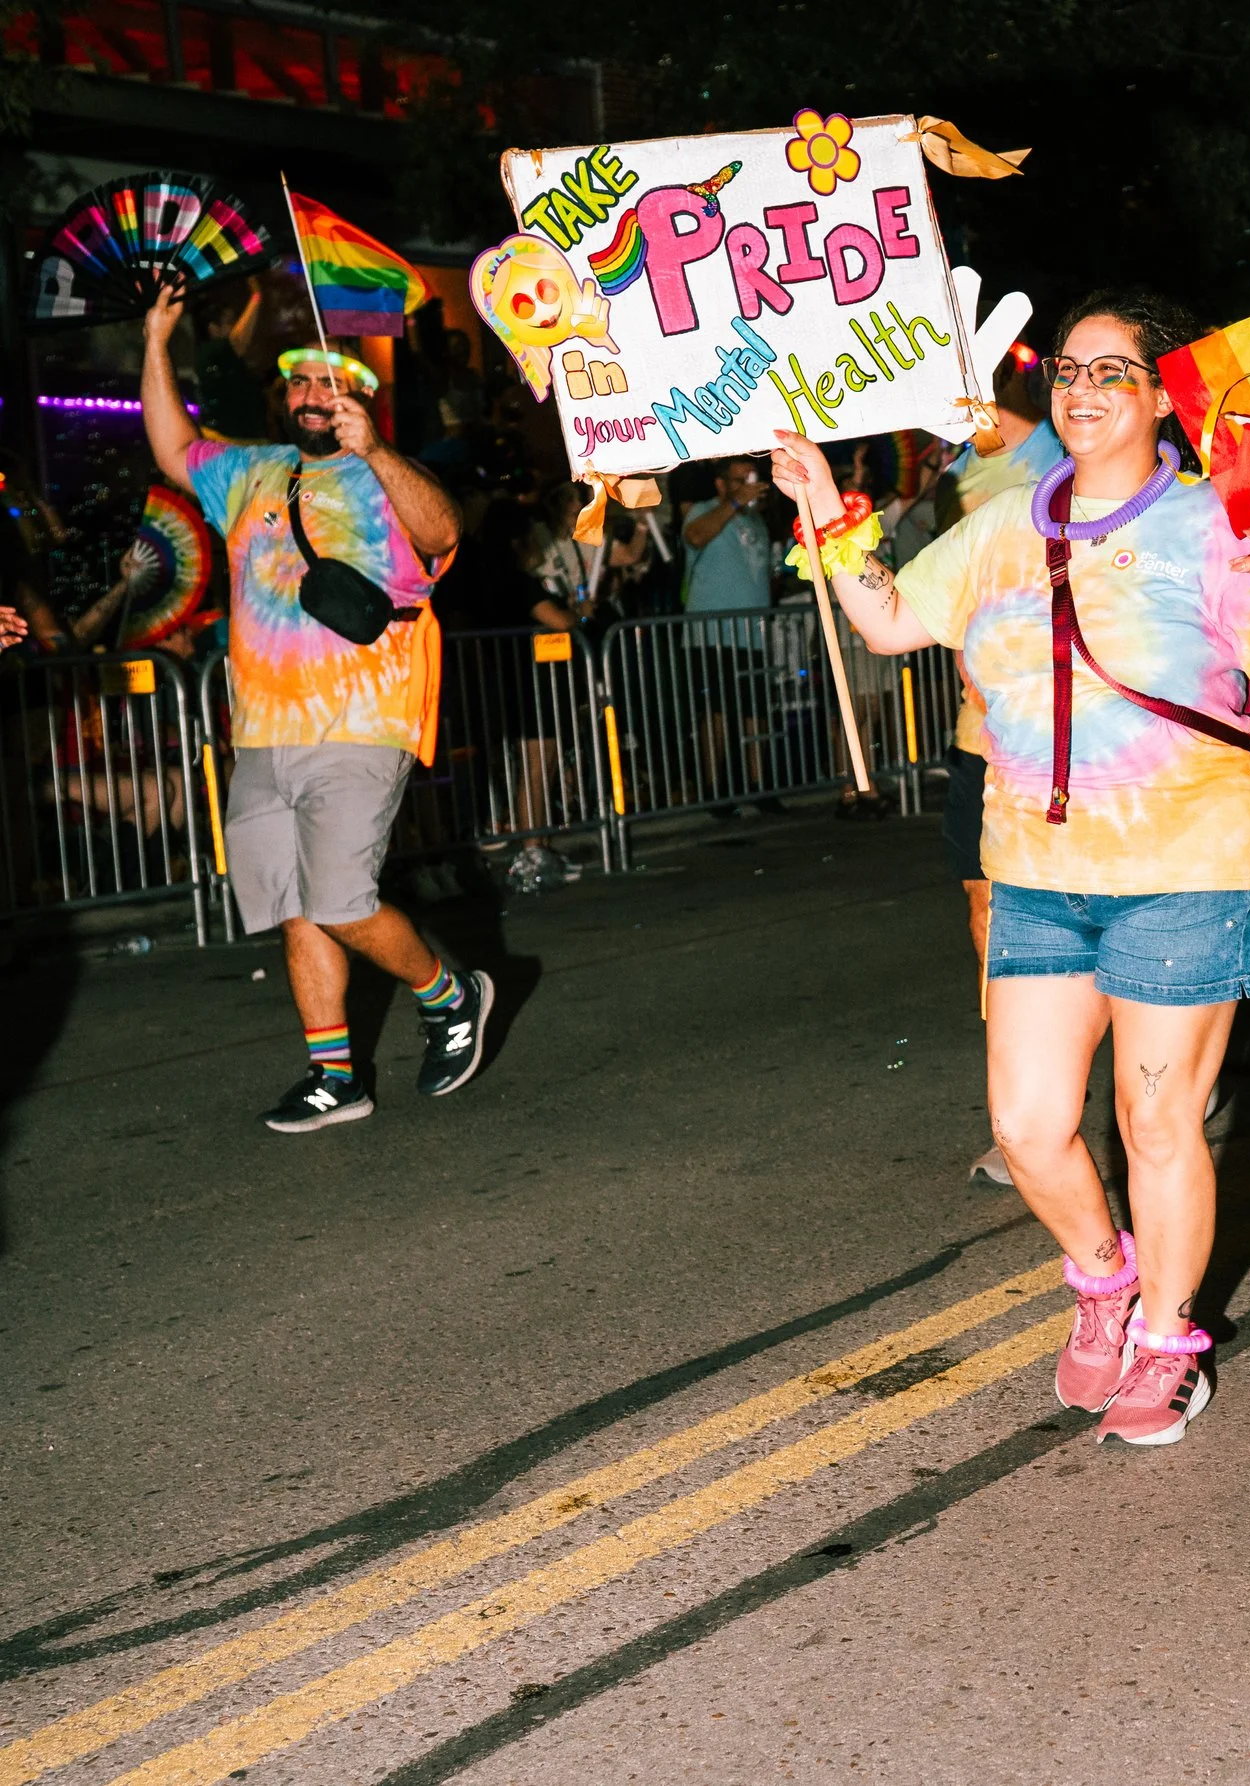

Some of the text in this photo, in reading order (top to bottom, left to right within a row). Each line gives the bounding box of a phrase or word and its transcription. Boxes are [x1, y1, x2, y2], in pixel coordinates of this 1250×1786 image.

[36, 184, 264, 318] PRIDE
[523, 146, 640, 251] TAKE
[636, 184, 920, 337] PRIDE
[561, 349, 629, 400] in
[573, 301, 950, 460] your Mental Health
[1136, 559, 1190, 579] center
